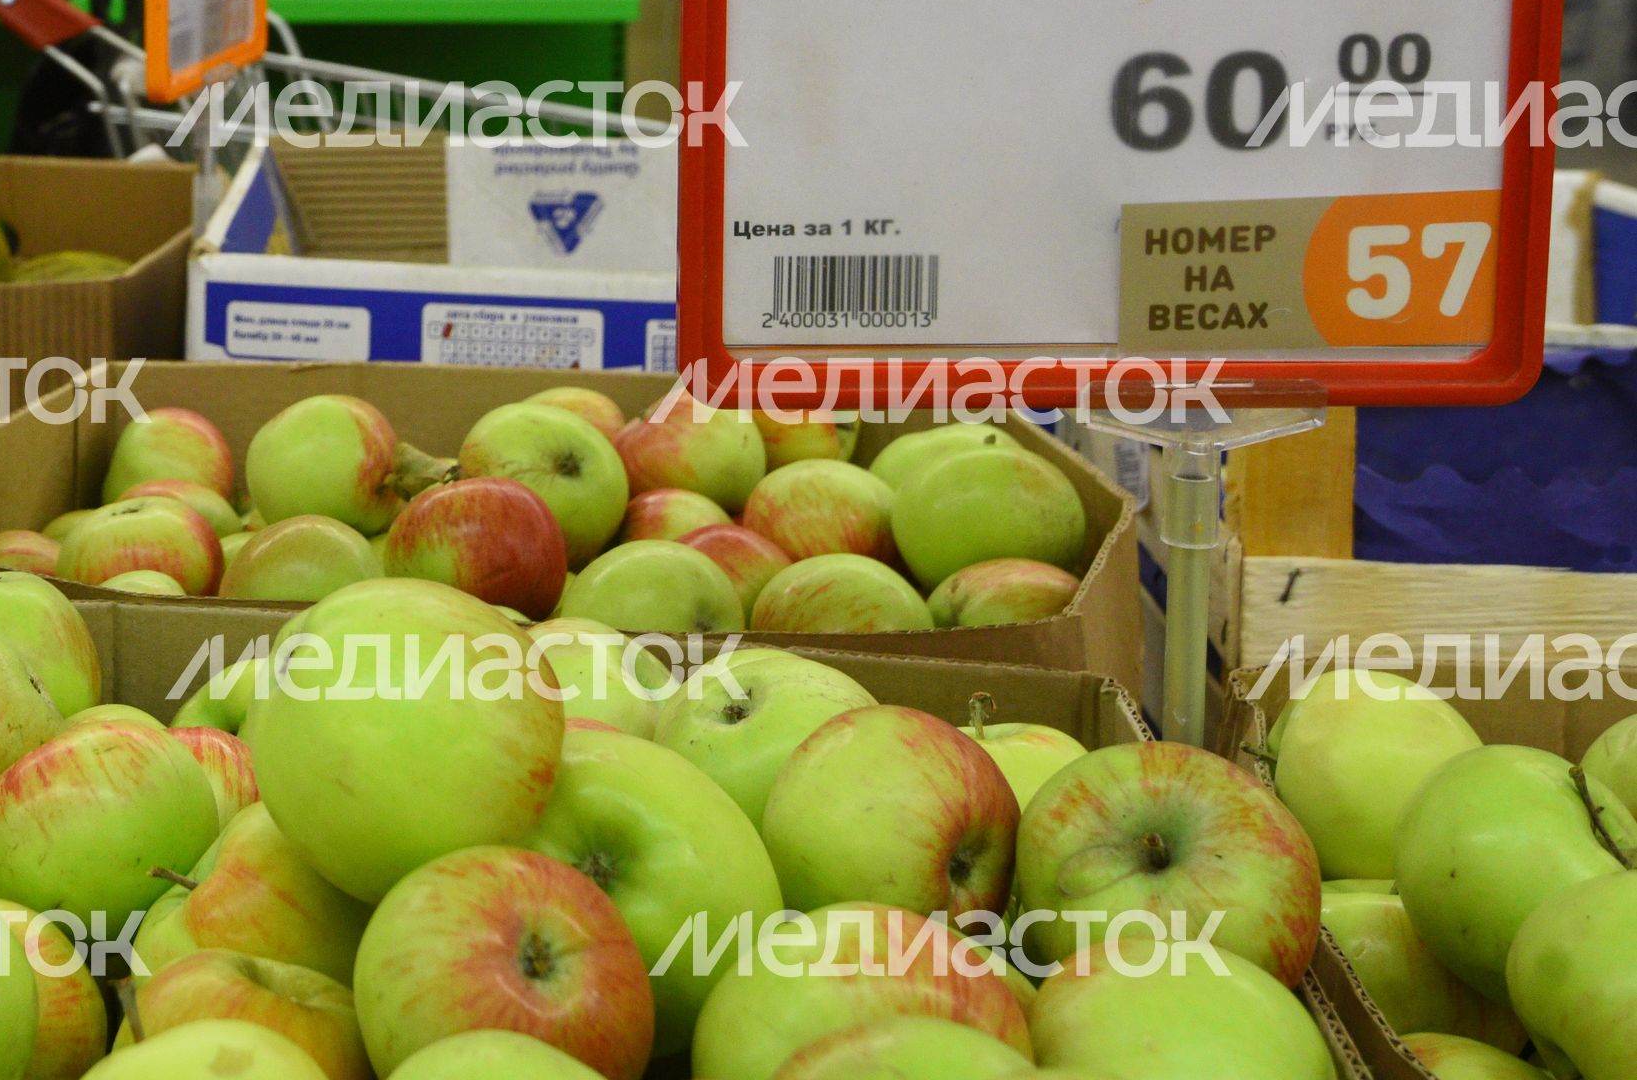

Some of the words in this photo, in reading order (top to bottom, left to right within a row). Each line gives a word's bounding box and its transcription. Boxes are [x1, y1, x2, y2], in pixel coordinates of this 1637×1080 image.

[1111, 50, 1288, 152] 60
[1337, 33, 1432, 83] 00
[734, 221, 795, 240] Цена
[804, 223, 831, 236] за
[841, 220, 852, 236] 1
[865, 219, 901, 236] КГ.
[1144, 225, 1276, 255] НОМЕР
[1184, 265, 1235, 292] НА
[1346, 221, 1491, 319] 57
[779, 312, 849, 329] 400031
[1148, 302, 1269, 331] ВЕСАХ
